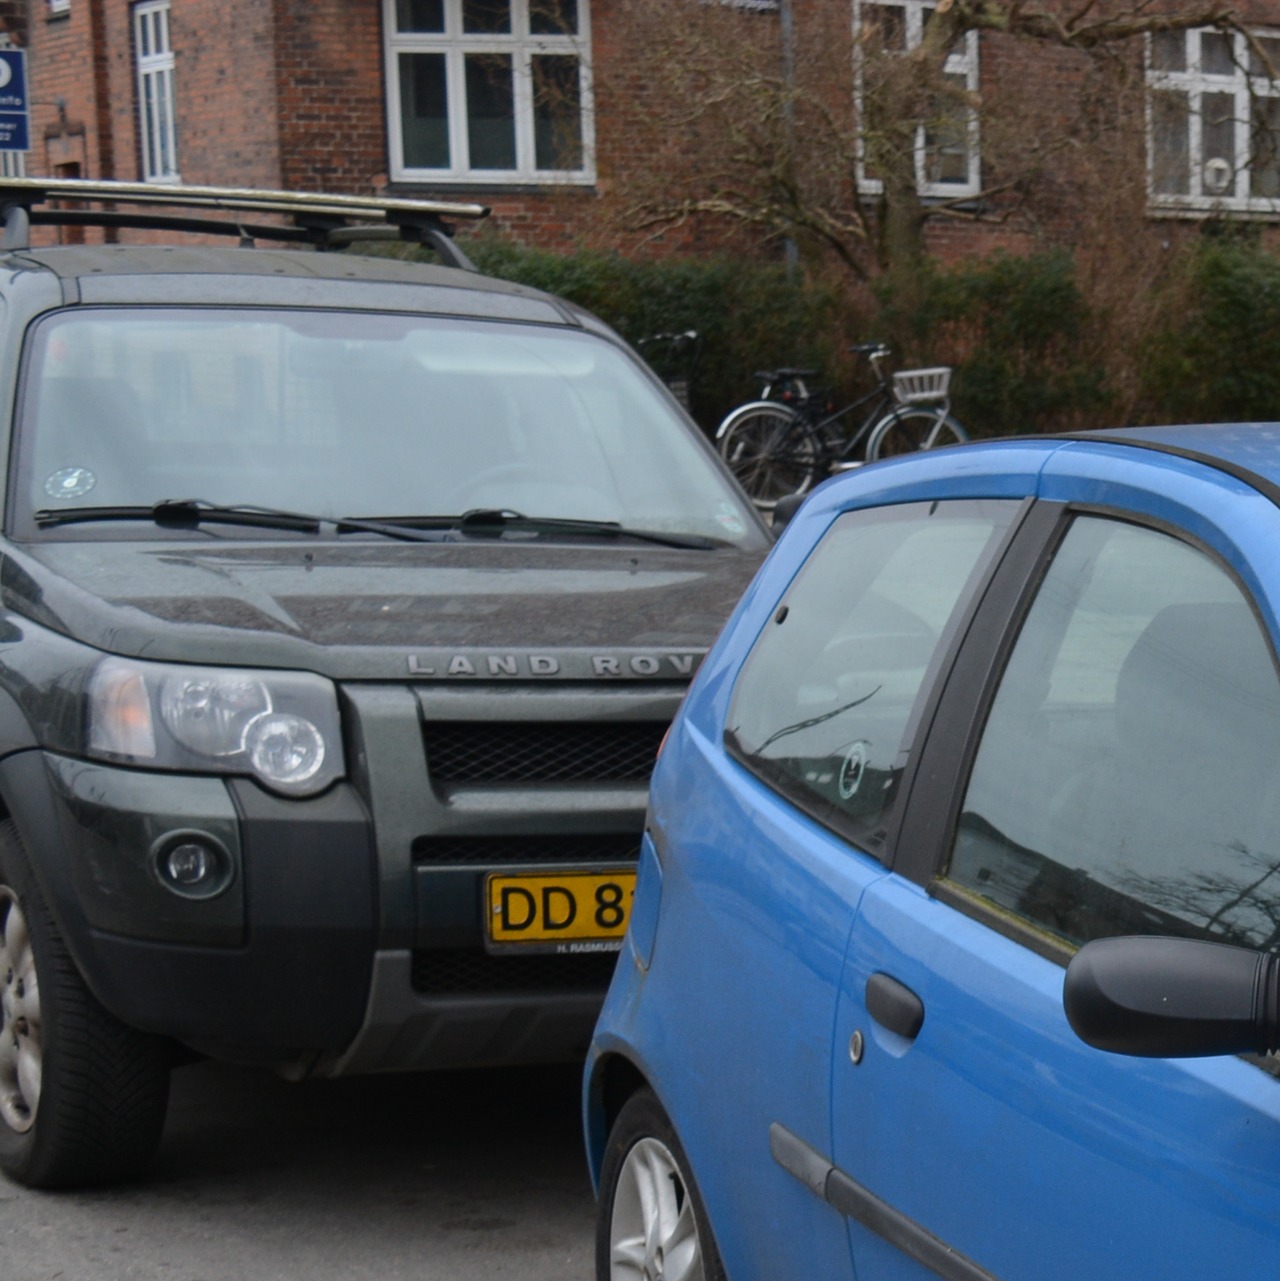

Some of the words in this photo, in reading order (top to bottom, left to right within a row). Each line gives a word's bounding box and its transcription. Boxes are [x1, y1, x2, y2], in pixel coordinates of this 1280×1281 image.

[406, 655, 561, 676] LAND
[501, 886, 577, 931] DD
[594, 883, 636, 929] 8
